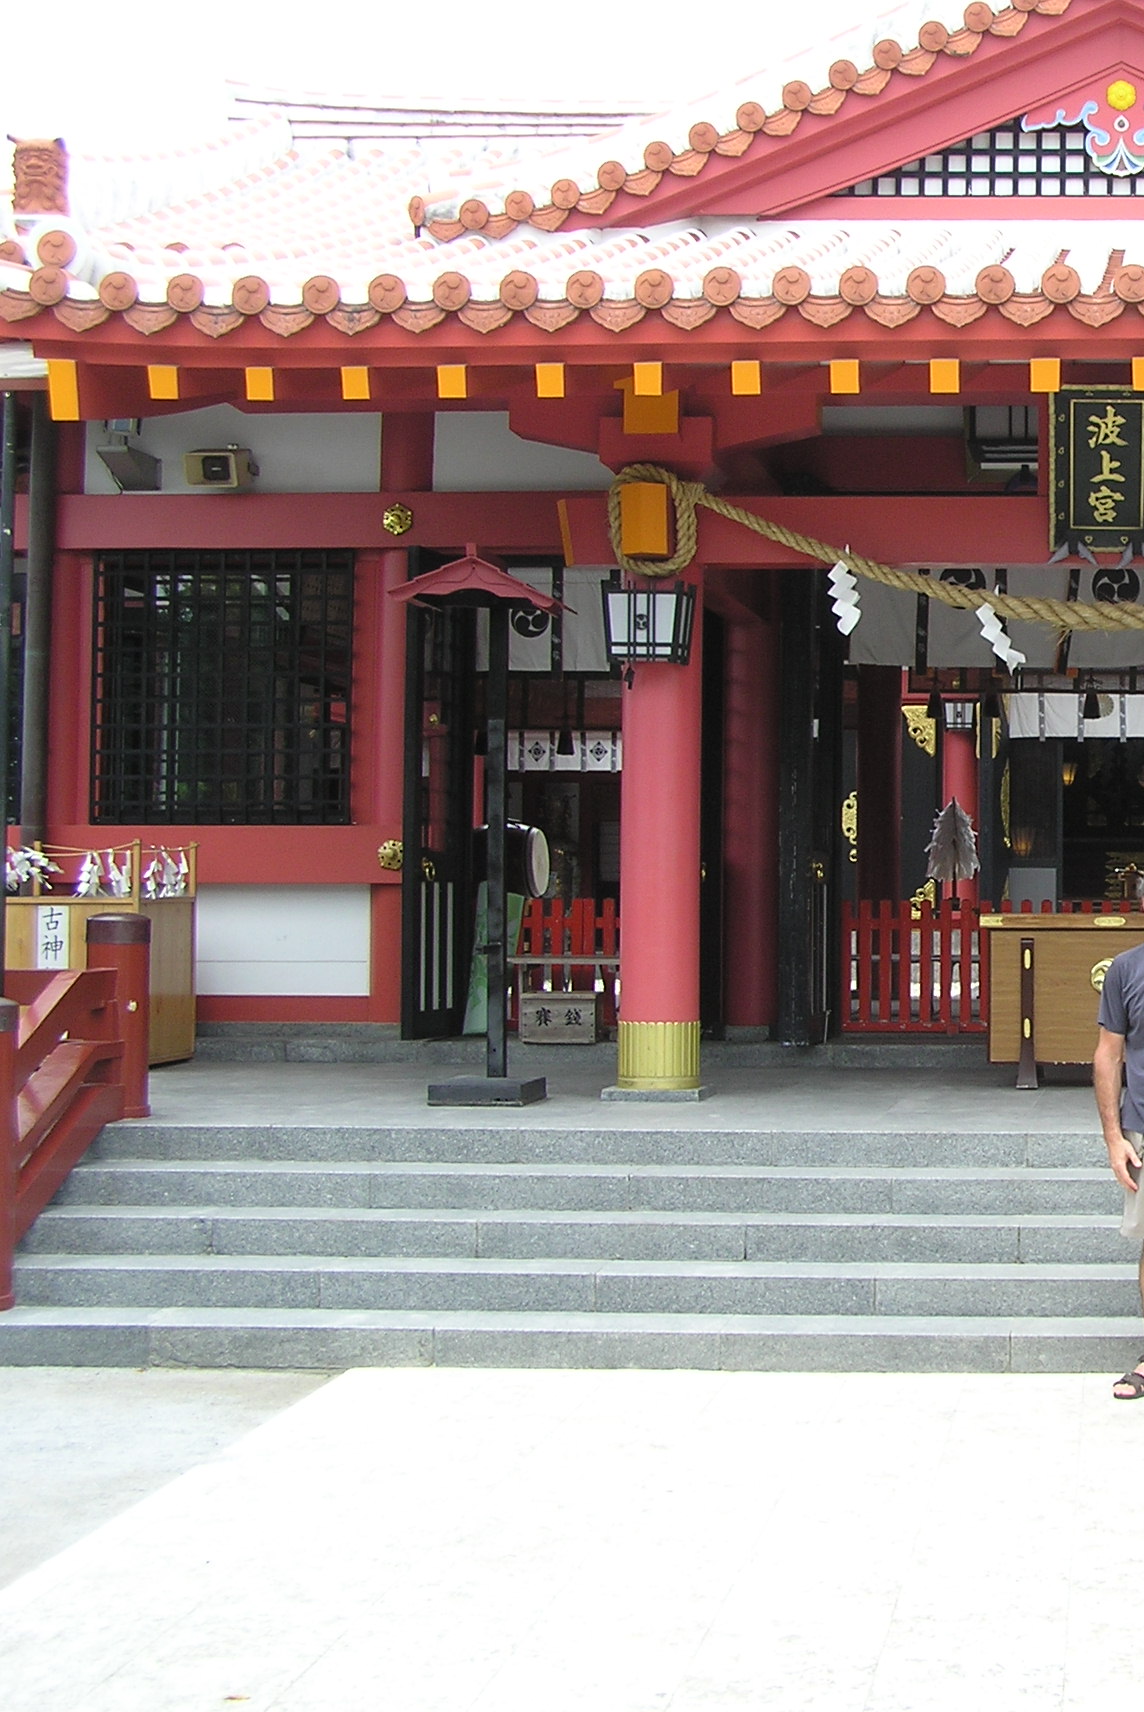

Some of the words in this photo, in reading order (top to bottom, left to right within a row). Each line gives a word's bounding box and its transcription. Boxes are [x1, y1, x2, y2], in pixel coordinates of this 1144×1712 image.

[1086, 405, 1129, 524] 波上宮
[42, 906, 64, 968] 古神
